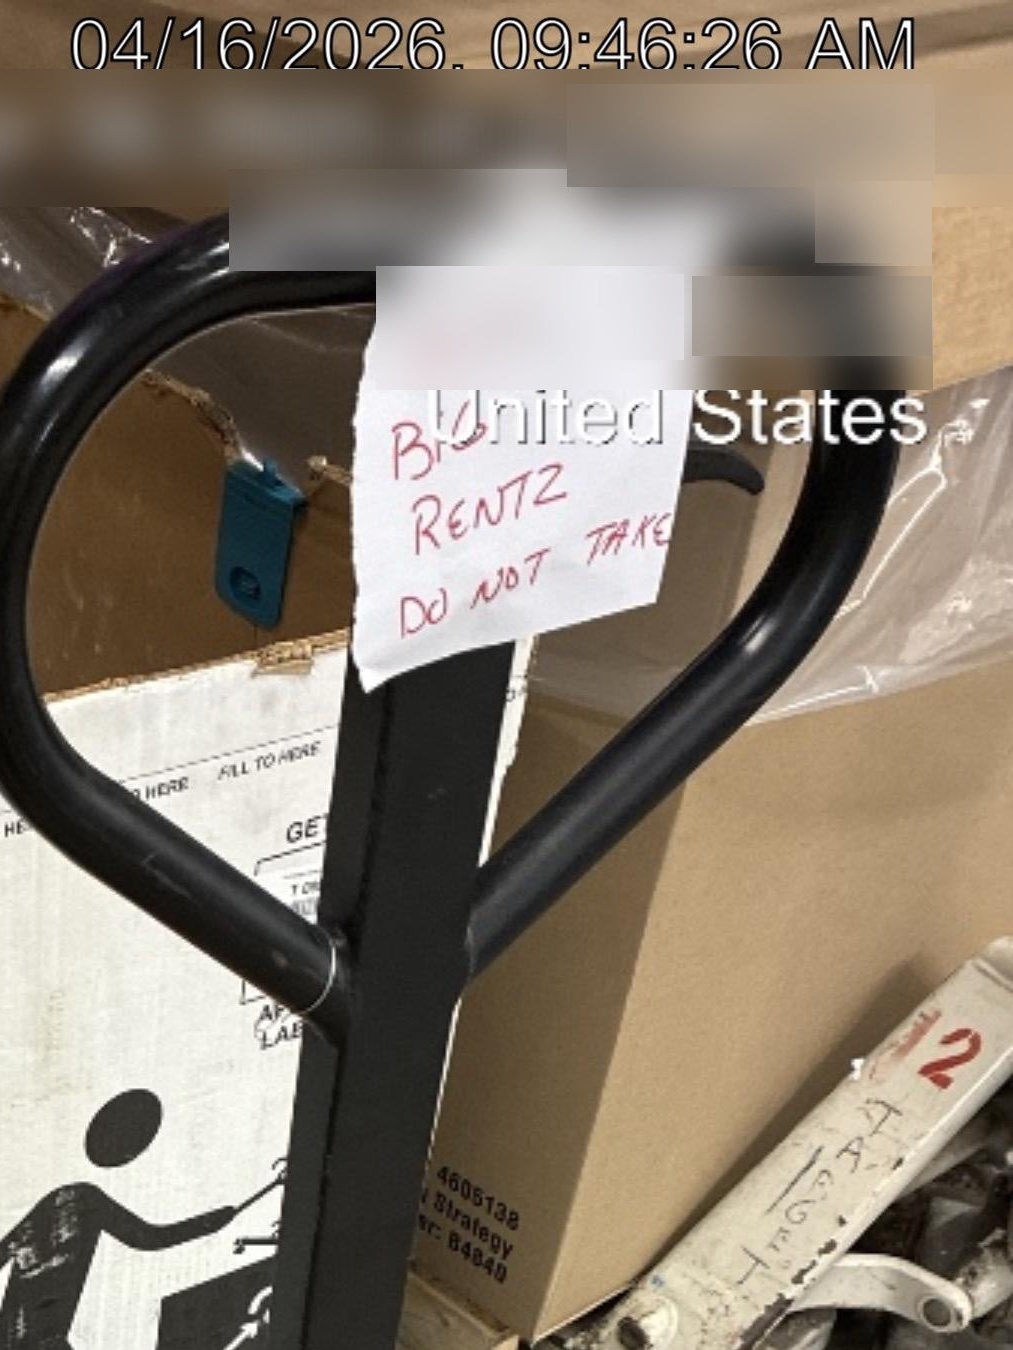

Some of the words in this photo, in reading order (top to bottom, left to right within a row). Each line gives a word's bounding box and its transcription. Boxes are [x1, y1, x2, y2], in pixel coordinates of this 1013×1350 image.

[399, 588, 448, 638] DO
[471, 547, 552, 608] NOT
[586, 512, 672, 566] TAKE
[218, 762, 249, 780] FILL
[254, 753, 275, 770] TO
[278, 740, 321, 765] HERE
[145, 776, 190, 801] HERE
[5, 819, 29, 838] HE
[433, 1191, 515, 1260] Strategy
